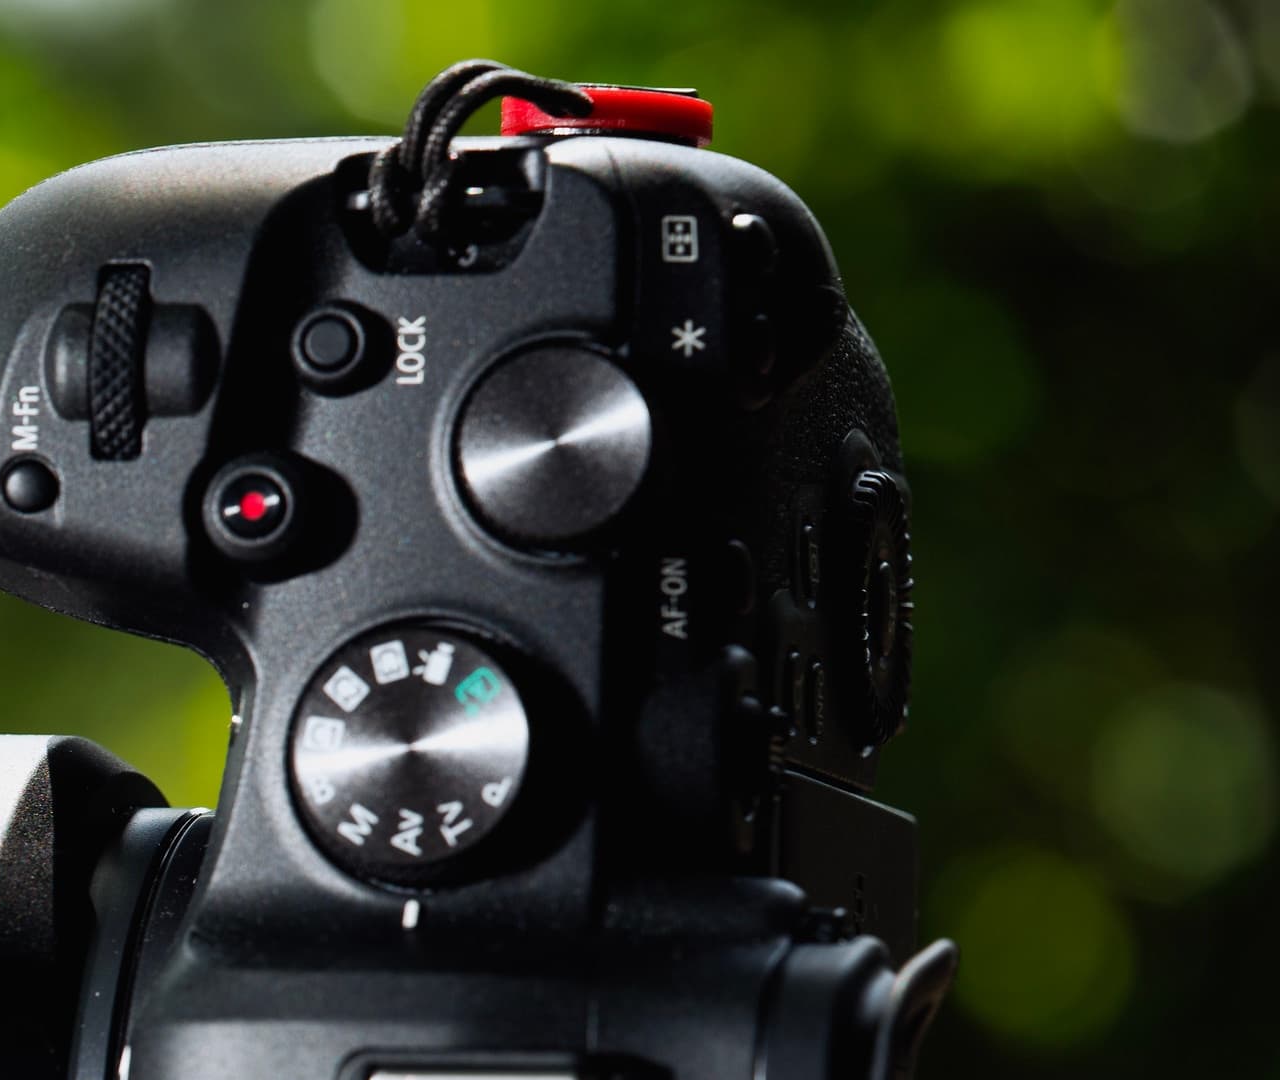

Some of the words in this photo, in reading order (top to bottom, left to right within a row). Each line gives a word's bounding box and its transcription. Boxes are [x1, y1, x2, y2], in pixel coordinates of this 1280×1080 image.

[396, 315, 426, 385] LOCK
[11, 386, 40, 450] M-Fn
[660, 557, 688, 640] AF-ON
[337, 803, 380, 846] M
